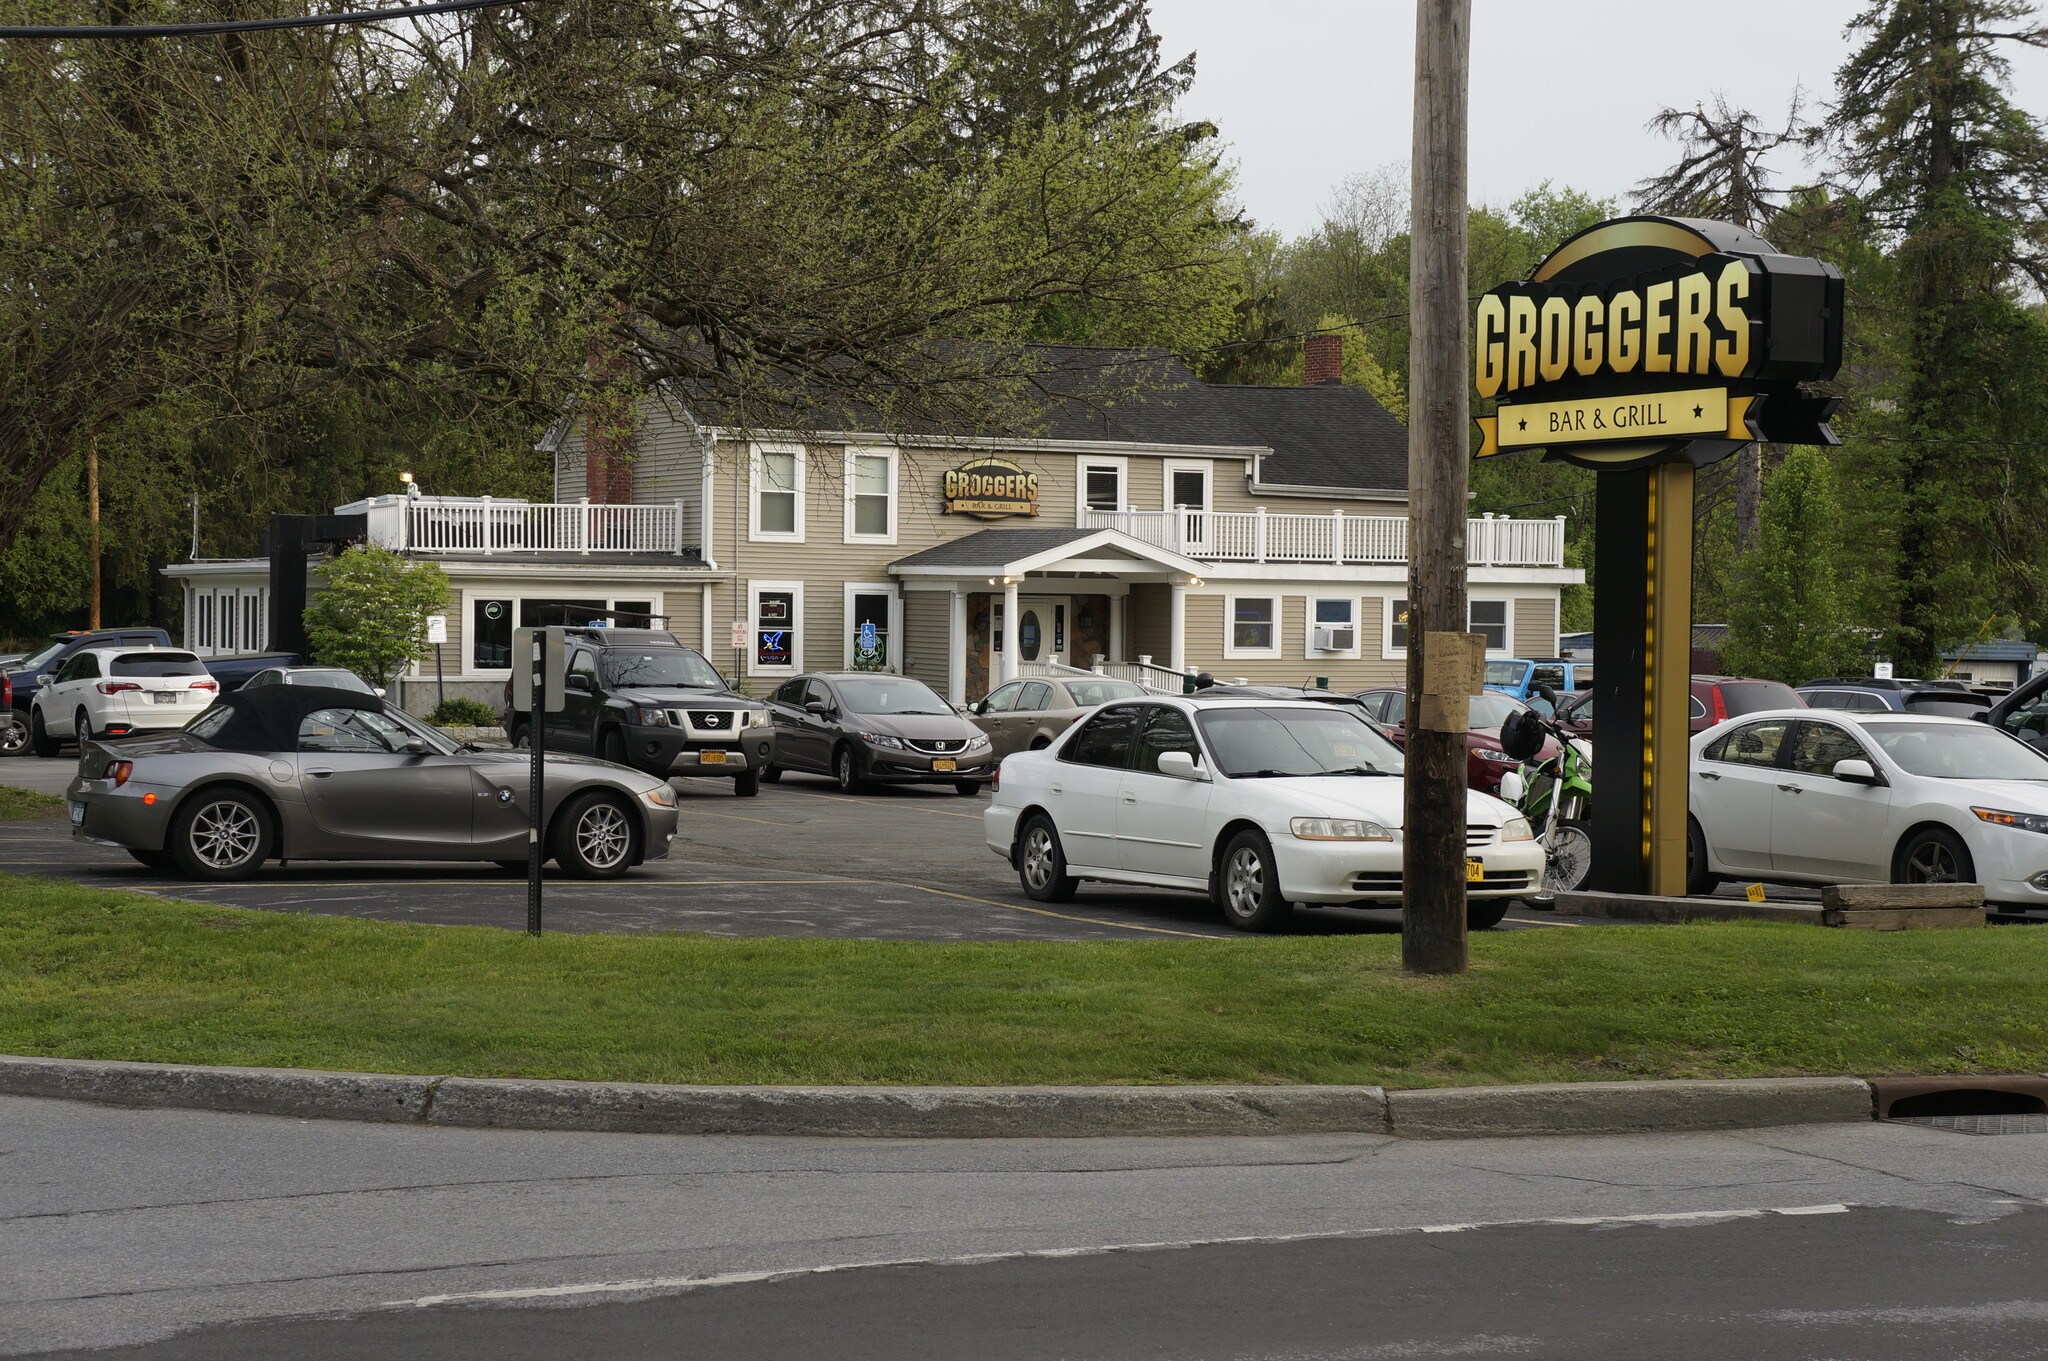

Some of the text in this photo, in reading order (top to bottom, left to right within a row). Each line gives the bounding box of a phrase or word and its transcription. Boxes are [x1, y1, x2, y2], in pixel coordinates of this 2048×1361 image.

[1475, 260, 1750, 399] GROGGERS
[1549, 403, 1667, 432] BAR & GRILL
[945, 470, 1038, 500] GROGGERS
